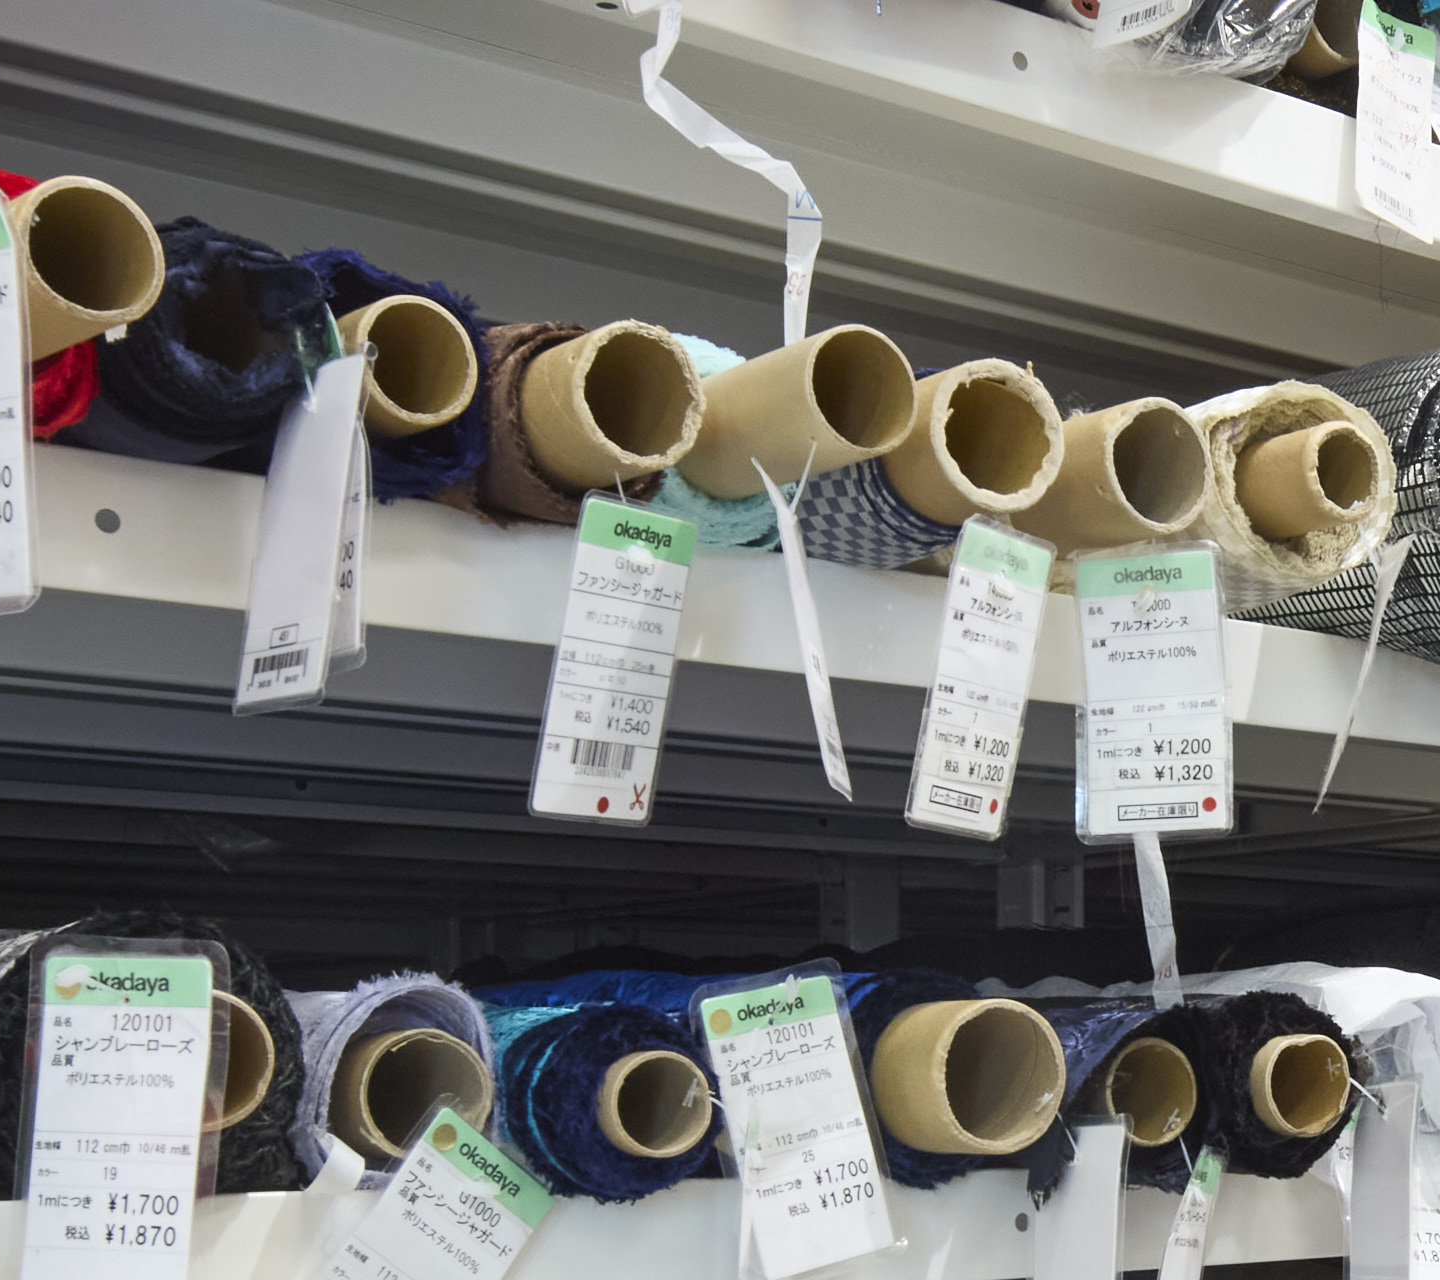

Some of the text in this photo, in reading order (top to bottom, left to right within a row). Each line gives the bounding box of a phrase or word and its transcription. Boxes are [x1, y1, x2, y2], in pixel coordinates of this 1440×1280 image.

[614, 519, 672, 548] okadaya
[1114, 564, 1182, 584] okadaya
[1108, 644, 1197, 662] ポリエステル100%
[972, 734, 1009, 758] ¥1,200
[1154, 738, 1212, 756] ¥1,200
[968, 759, 1004, 782] ¥1,320
[1154, 764, 1213, 782] ¥1,320
[1120, 804, 1196, 819] メーカー在庫限り
[111, 1013, 173, 1034] 120101
[765, 1021, 816, 1046] 120101
[53, 1034, 194, 1055] シャンブレーローズ
[726, 1035, 837, 1072] シャンブレーローズ
[65, 1071, 175, 1090] ポリエステル100%
[745, 1067, 832, 1097] ポリエステル100%
[458, 1140, 521, 1200] okadaya
[813, 1157, 870, 1187] ¥1,700
[107, 1192, 179, 1217] ¥1,700
[818, 1181, 875, 1210] ¥1,870
[401, 1168, 514, 1260] ファンシージャガード
[105, 1225, 177, 1248] ¥1,870
